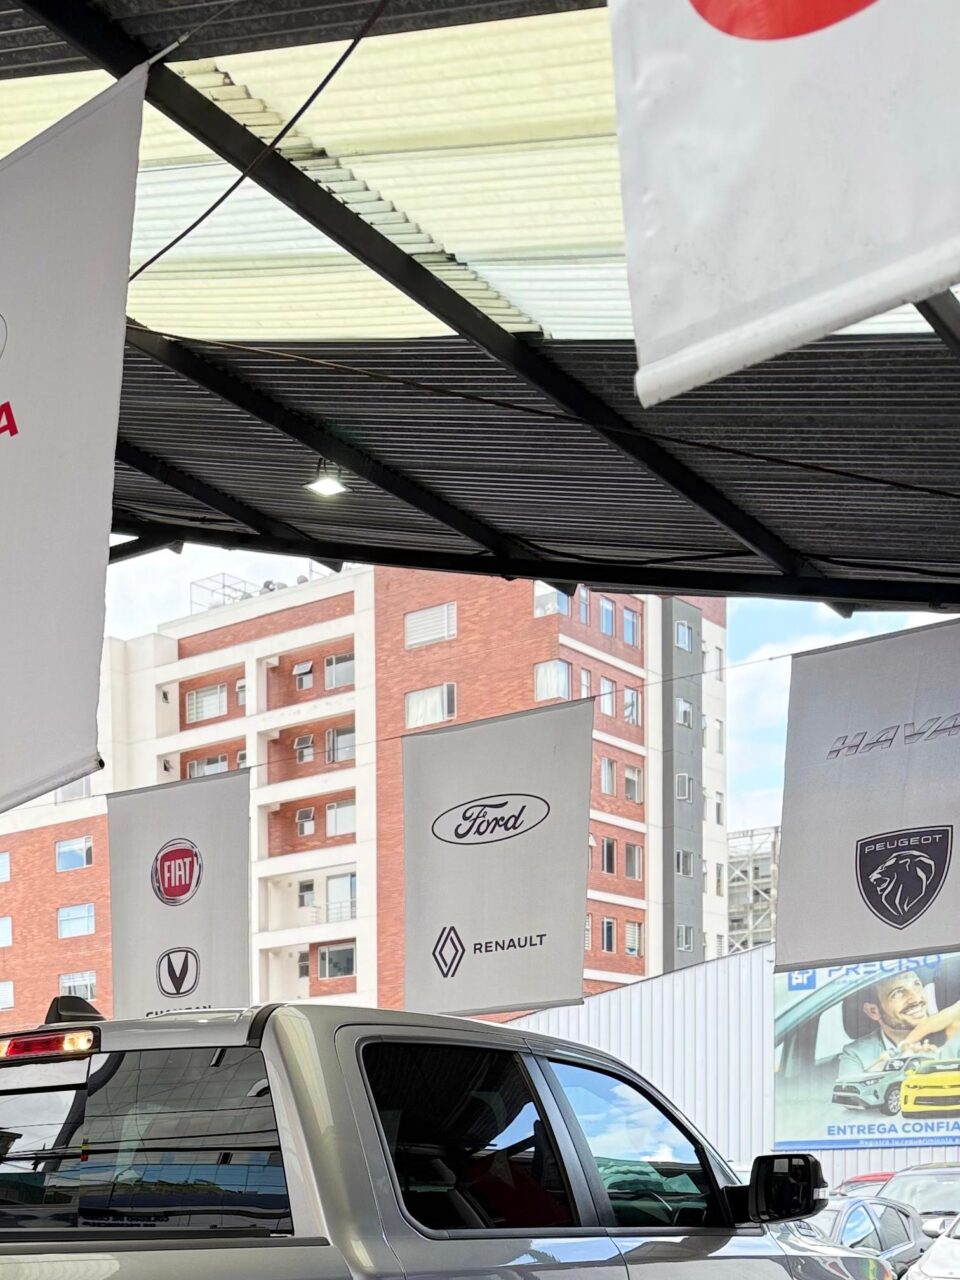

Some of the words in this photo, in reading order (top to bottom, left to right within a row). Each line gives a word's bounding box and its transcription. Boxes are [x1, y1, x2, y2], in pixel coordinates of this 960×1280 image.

[454, 800, 527, 839] Ford
[864, 834, 943, 854] PEUGEOT
[163, 856, 193, 888] FIAT
[473, 933, 547, 954] RENAULT
[827, 1123, 898, 1136] ENTREGA
